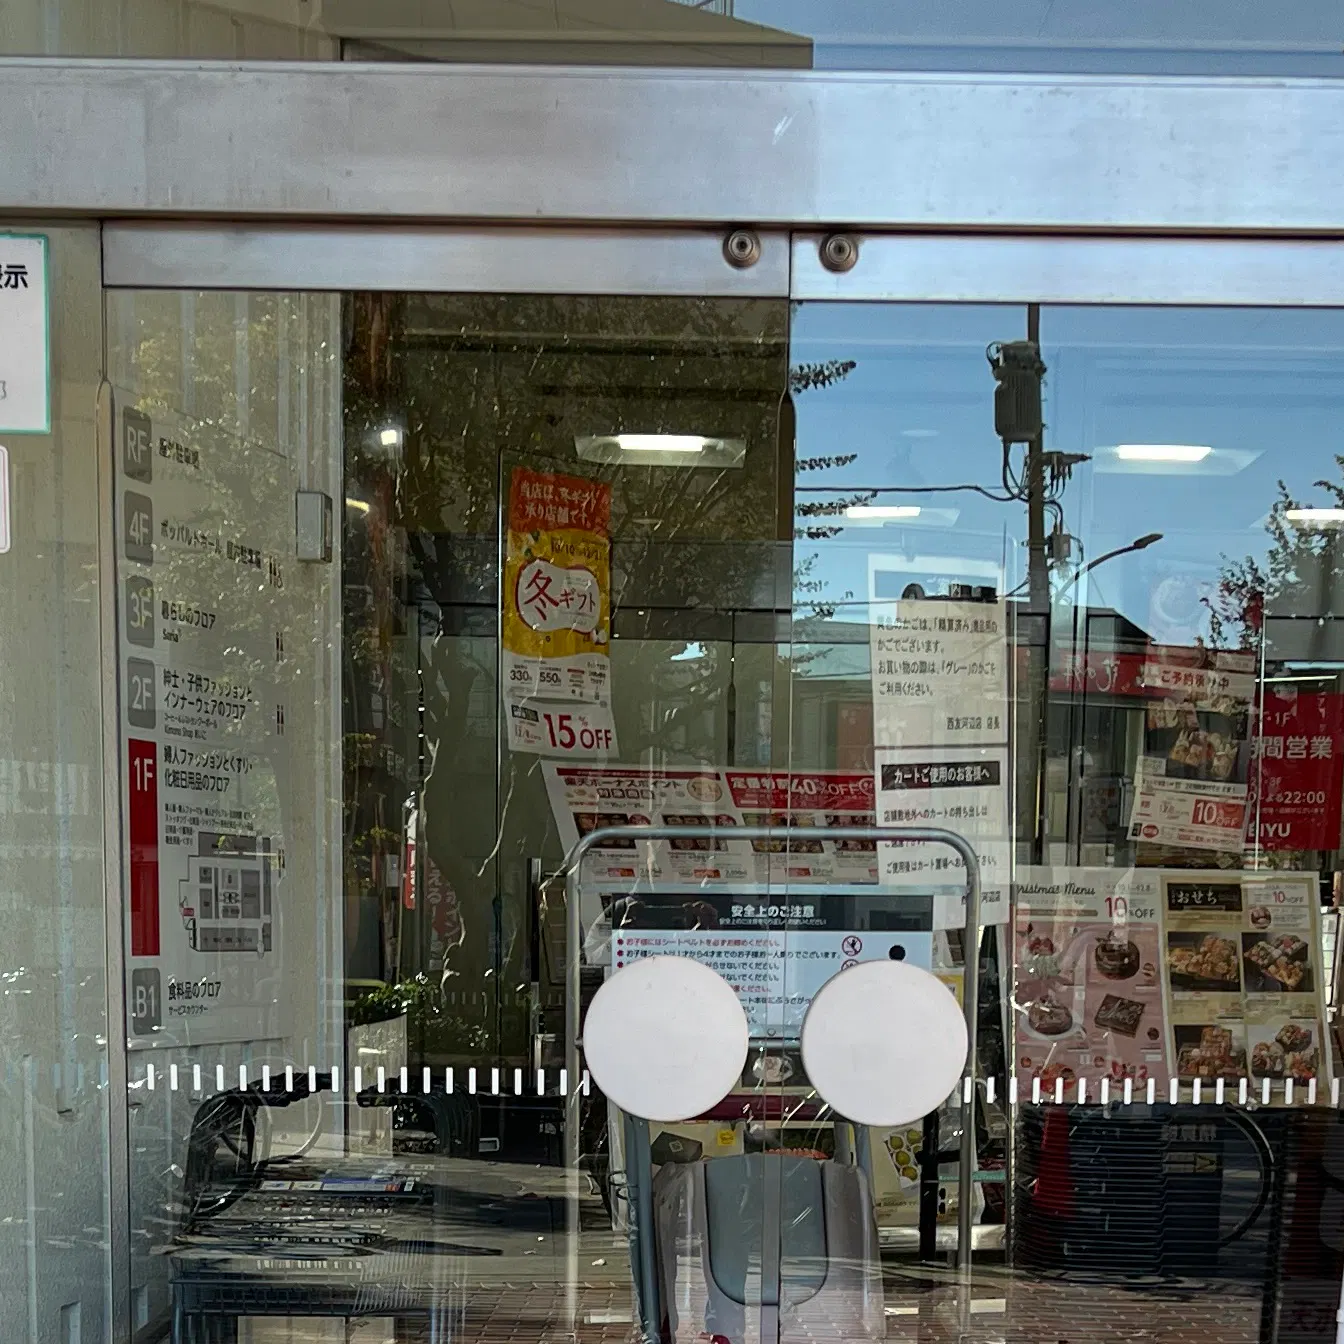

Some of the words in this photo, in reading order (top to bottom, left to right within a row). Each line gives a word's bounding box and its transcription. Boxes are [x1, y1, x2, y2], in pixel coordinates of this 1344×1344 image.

[126, 425, 148, 464] RF
[129, 511, 149, 547] 4F
[130, 590, 154, 630] 3F
[523, 568, 597, 621] 冬ギフト
[131, 674, 153, 711] 2F
[133, 756, 154, 792] 1F
[894, 765, 991, 785] カートご使用のお客様へ
[1246, 822, 1292, 839] EIYU
[1017, 882, 1061, 896] ristmas
[1064, 881, 1096, 896] Menu
[1177, 890, 1218, 905] おせち
[731, 904, 815, 918] 安全上のご注意
[135, 984, 155, 1019] B1
[168, 981, 222, 1001] 食料品のフロア
